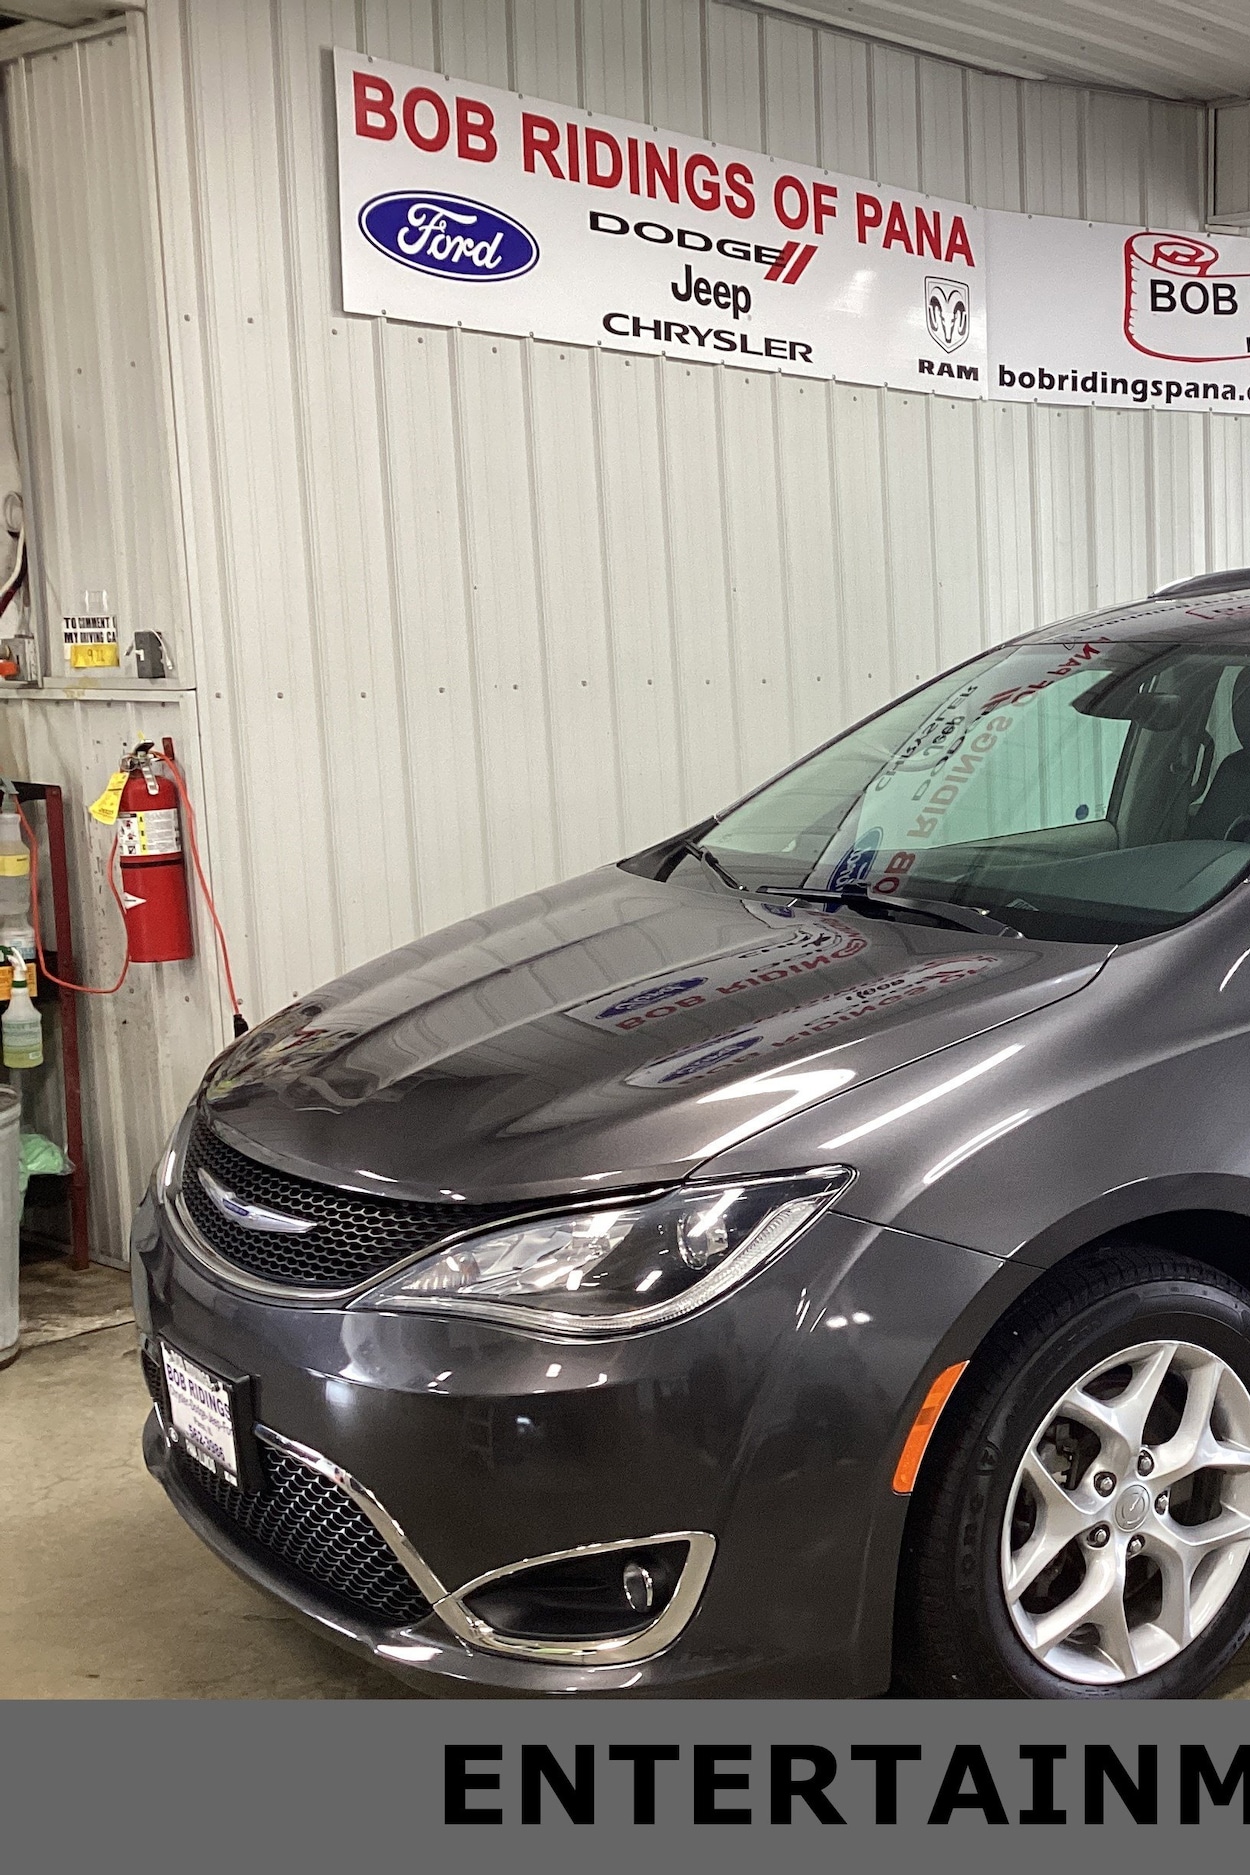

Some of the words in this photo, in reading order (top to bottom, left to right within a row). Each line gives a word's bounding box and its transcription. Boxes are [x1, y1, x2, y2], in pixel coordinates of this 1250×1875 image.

[352, 71, 498, 163] BOB
[521, 112, 756, 220] RIDINGS
[773, 175, 838, 235] OF
[856, 193, 975, 267] PANA
[397, 203, 504, 269] Ford
[588, 210, 786, 267] DODGE
[671, 264, 752, 319] Jeep
[1150, 279, 1239, 316] BOB
[602, 312, 813, 363] CHRYSLER
[918, 358, 979, 381] RAM
[63, 617, 77, 629] TO
[64, 632, 78, 643] MY
[166, 1363, 187, 1392] BOB
[188, 1379, 232, 1420] RIDINGS
